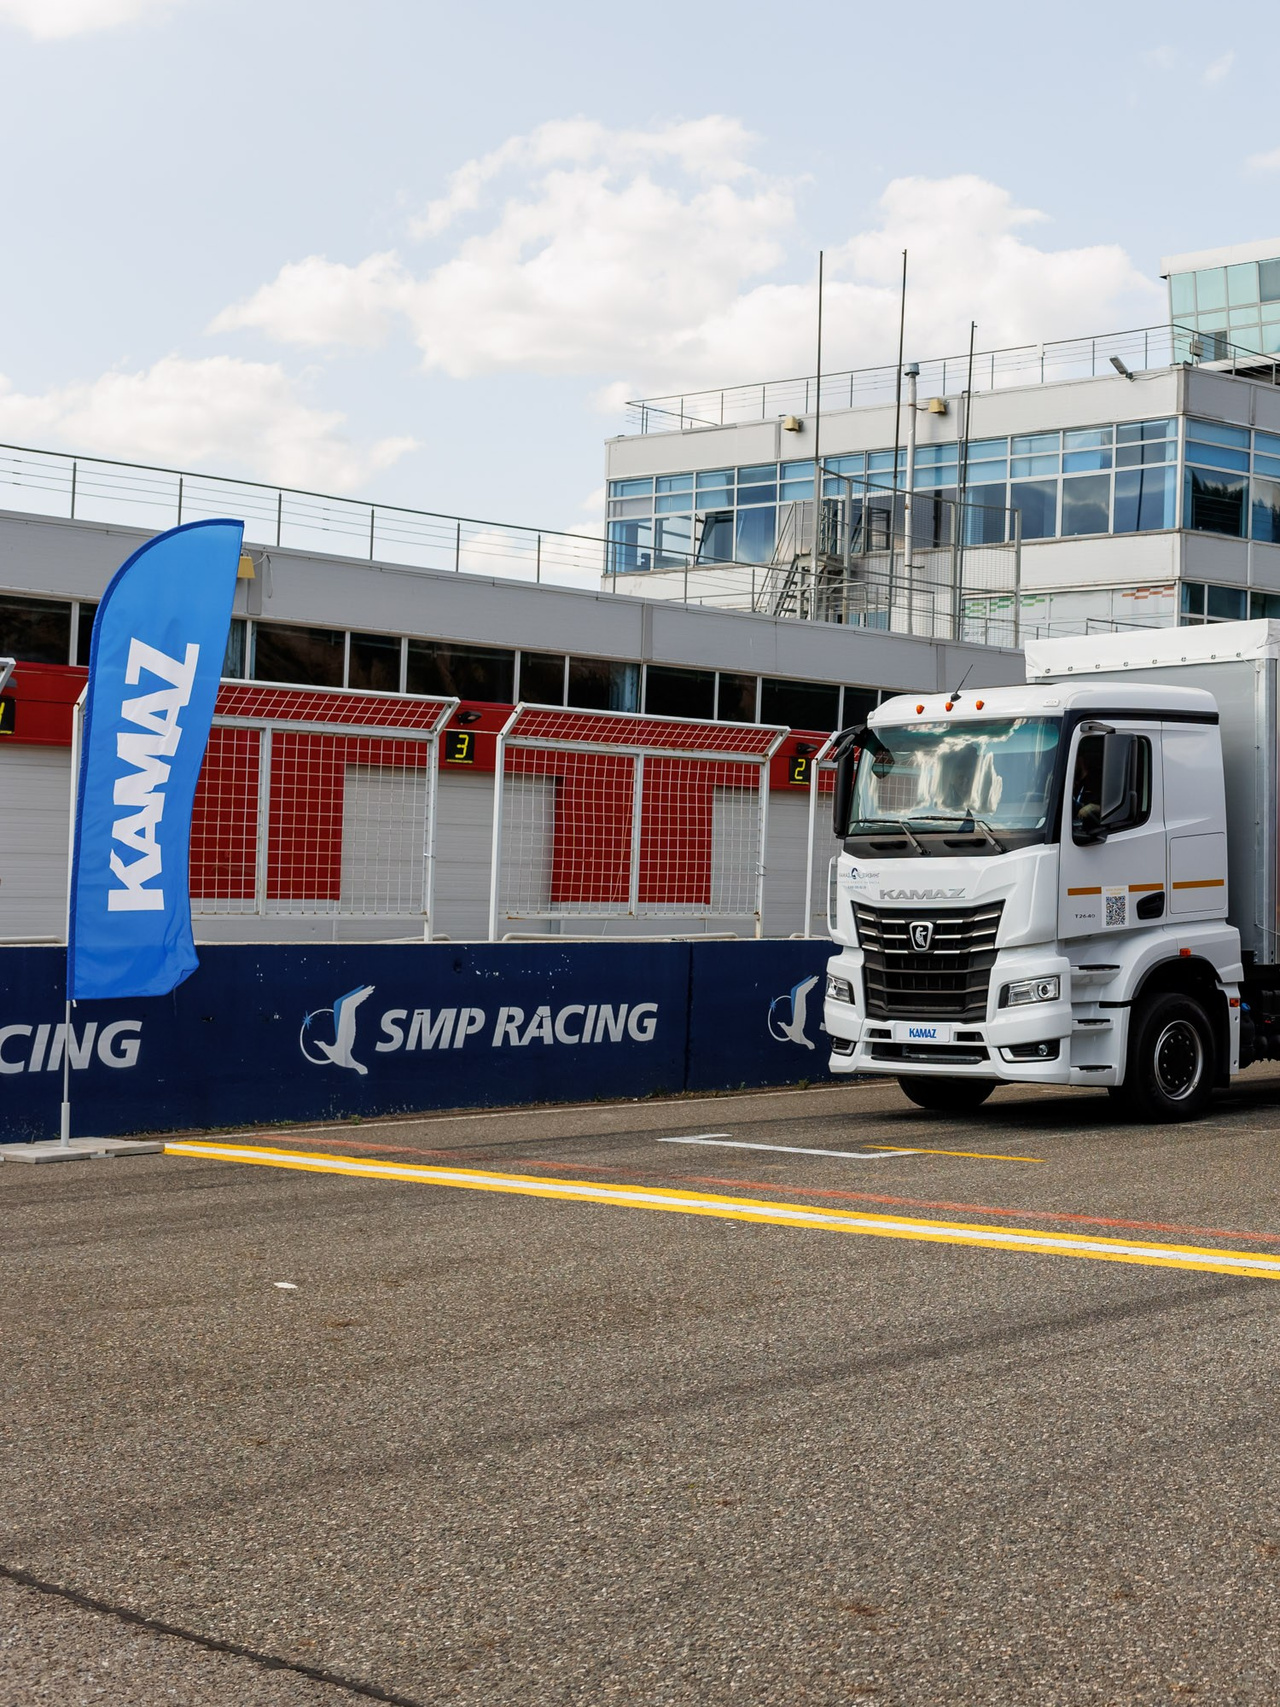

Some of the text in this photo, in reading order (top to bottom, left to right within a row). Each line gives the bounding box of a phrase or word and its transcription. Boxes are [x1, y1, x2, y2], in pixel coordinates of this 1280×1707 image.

[455, 734, 469, 758] 3
[107, 636, 200, 912] KAMAZ
[794, 758, 806, 780] 2
[879, 888, 966, 900] KAMAZ
[375, 1003, 658, 1053] SMP RACING
[909, 1028, 937, 1039] KAMAZ
[0, 1020, 143, 1074] CING
